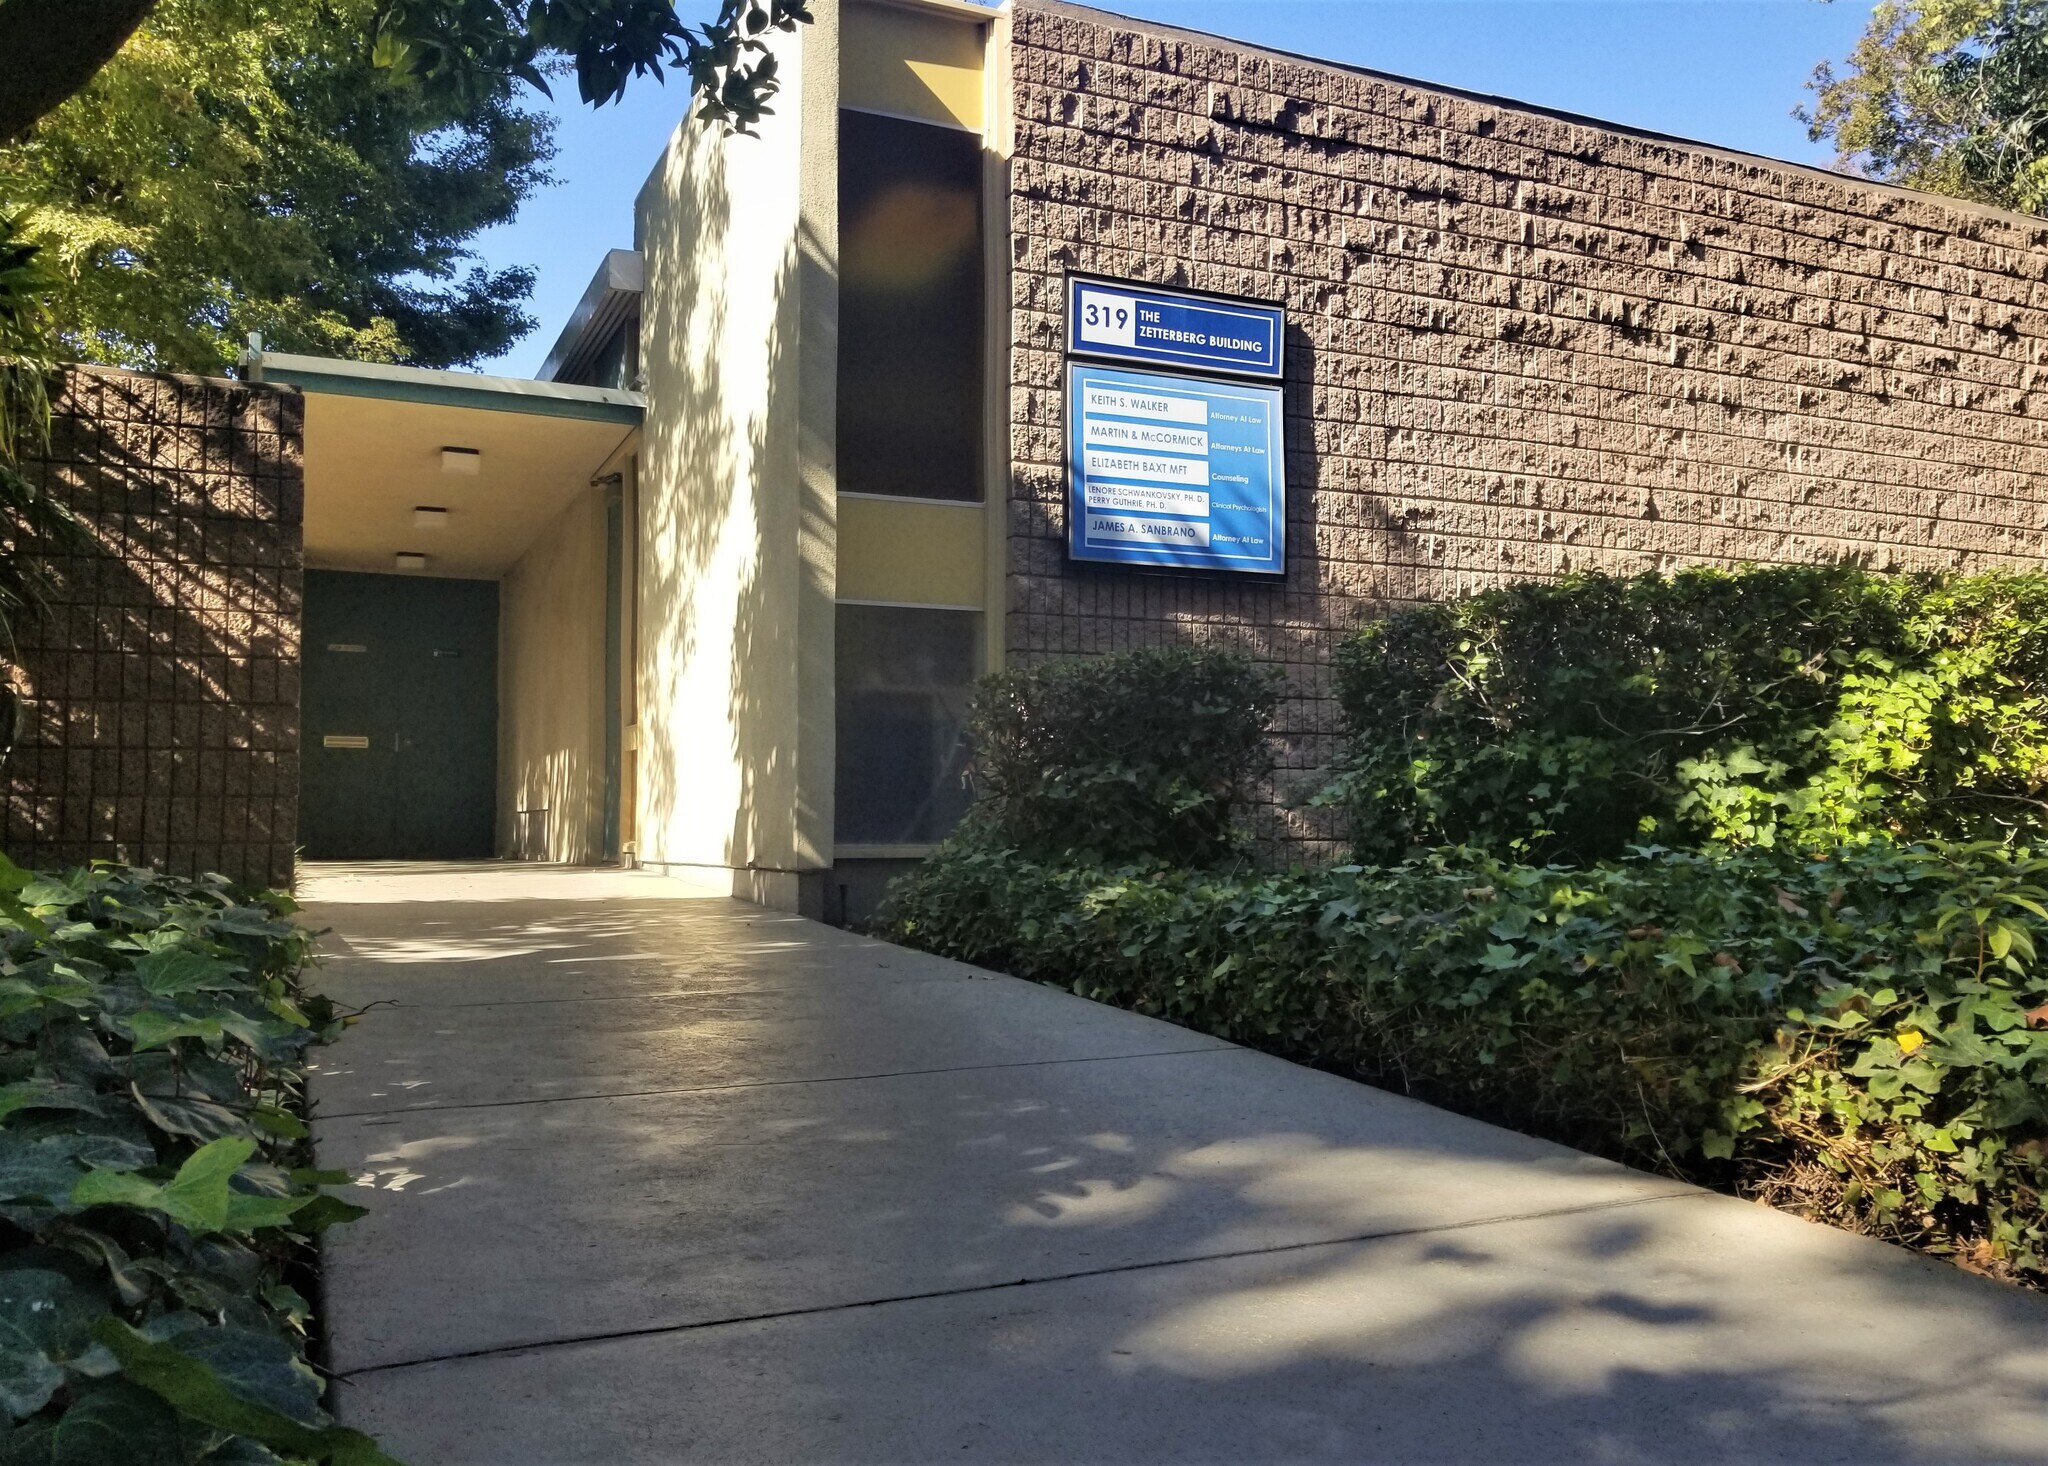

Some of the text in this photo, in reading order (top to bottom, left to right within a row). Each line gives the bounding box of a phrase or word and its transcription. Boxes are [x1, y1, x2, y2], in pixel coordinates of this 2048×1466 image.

[1085, 303, 1128, 330] 319
[1139, 310, 1160, 323] THE
[1139, 326, 1263, 353] ZETTERBERG BUILDING
[1091, 394, 1169, 412] KEITH S. WALKER
[1210, 411, 1238, 423] Attorney
[1248, 416, 1262, 424] Law
[1090, 426, 1204, 447] MARTIN & McCORMICK
[1210, 442, 1242, 453] Attorneys
[1252, 446, 1266, 455] Law
[1091, 457, 1188, 475] ELIZABETH BAXT MFT
[1211, 472, 1249, 485] Counseling
[1088, 485, 1117, 495] LENORE
[1184, 494, 1195, 502] PH.
[1197, 495, 1205, 503] D.
[1088, 496, 1111, 505] PERRY
[1146, 501, 1157, 509] PH.
[1159, 501, 1167, 510] D.
[1211, 501, 1231, 510] Clinical
[1092, 520, 1196, 538] JAMES A. SANBRANO
[1212, 533, 1240, 544] Attorney
[1250, 536, 1264, 545] Law
